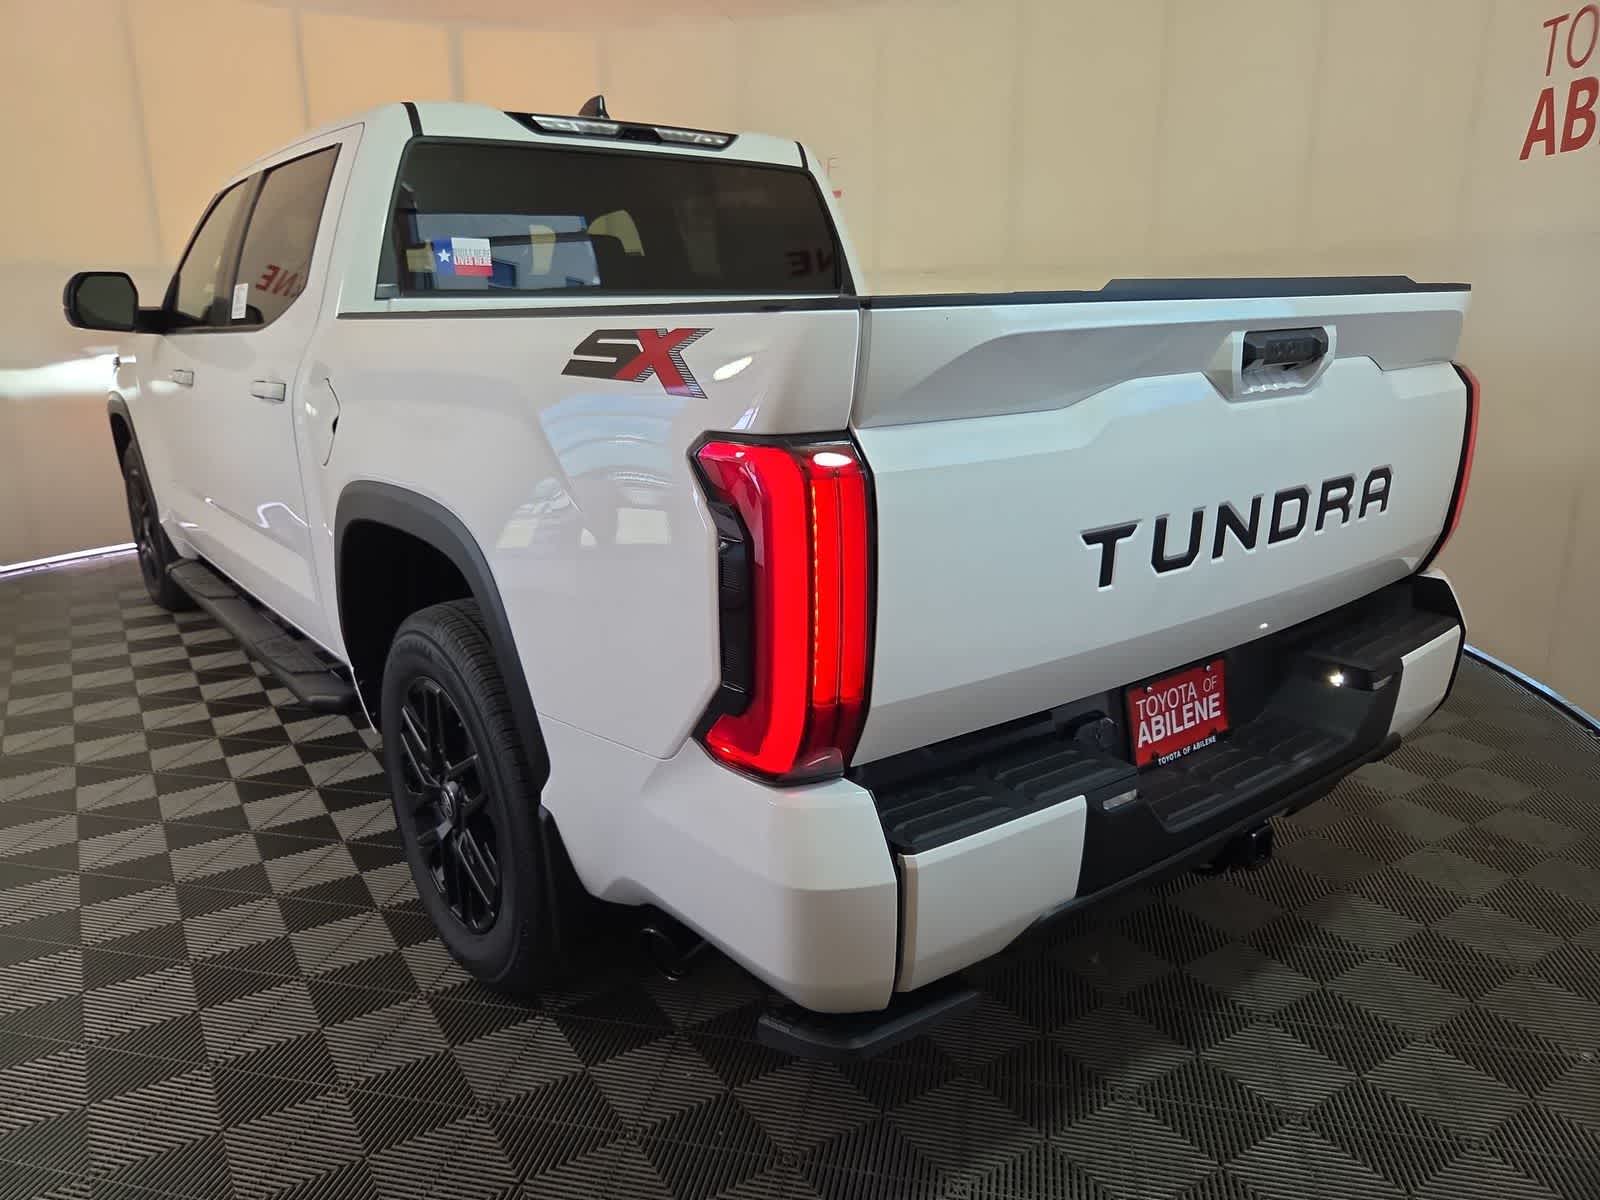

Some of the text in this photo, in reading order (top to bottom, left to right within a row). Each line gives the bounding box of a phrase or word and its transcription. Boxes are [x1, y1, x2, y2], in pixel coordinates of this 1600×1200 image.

[1519, 76, 1600, 161] AB
[1080, 464, 1393, 590] TUNDRA
[1136, 675, 1218, 720] TOYOTA OF
[1138, 693, 1221, 748] ABILENE
[1158, 735, 1217, 766] TOYOTA OF ABILENE
